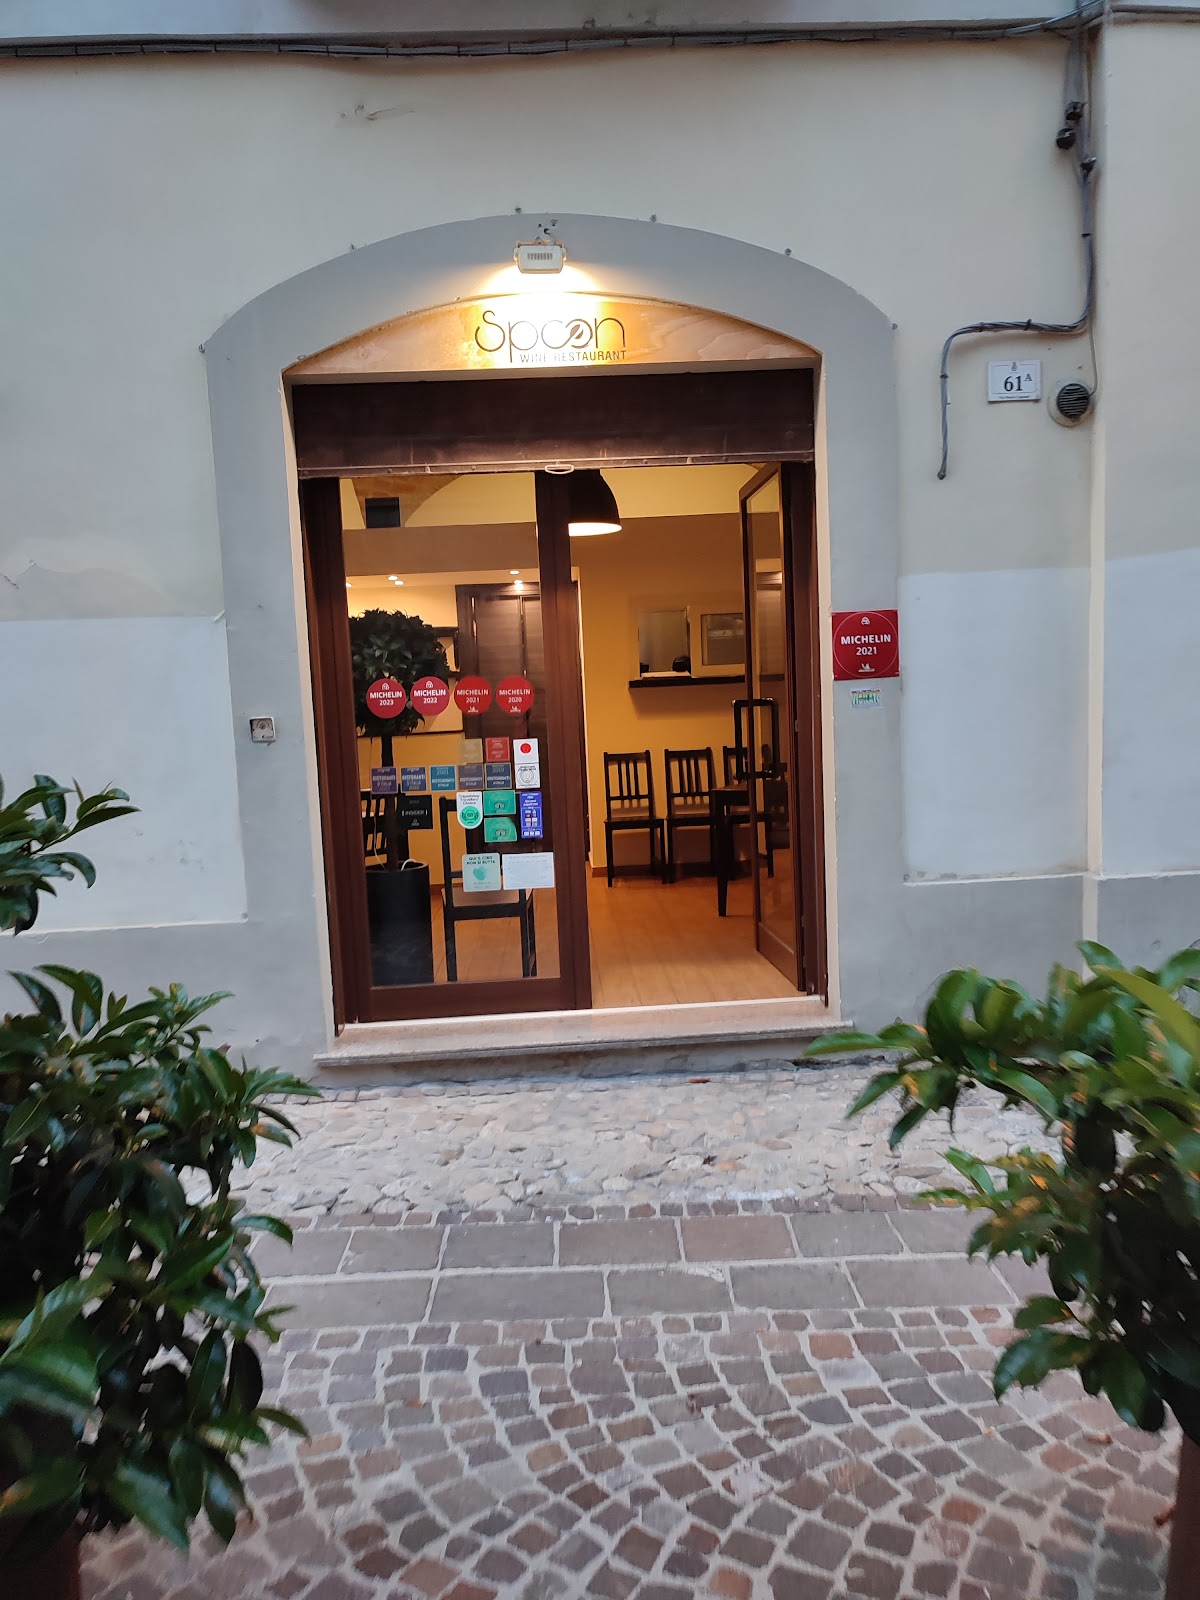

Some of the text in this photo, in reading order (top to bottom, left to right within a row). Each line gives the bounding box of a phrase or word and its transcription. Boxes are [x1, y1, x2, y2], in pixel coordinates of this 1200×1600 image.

[519, 350, 627, 363] WINE RESTAURANT
[841, 634, 891, 645] MICHELIN
[856, 647, 877, 656] 2021
[369, 691, 403, 699] MICHELIN
[413, 689, 446, 697] MICHELIN
